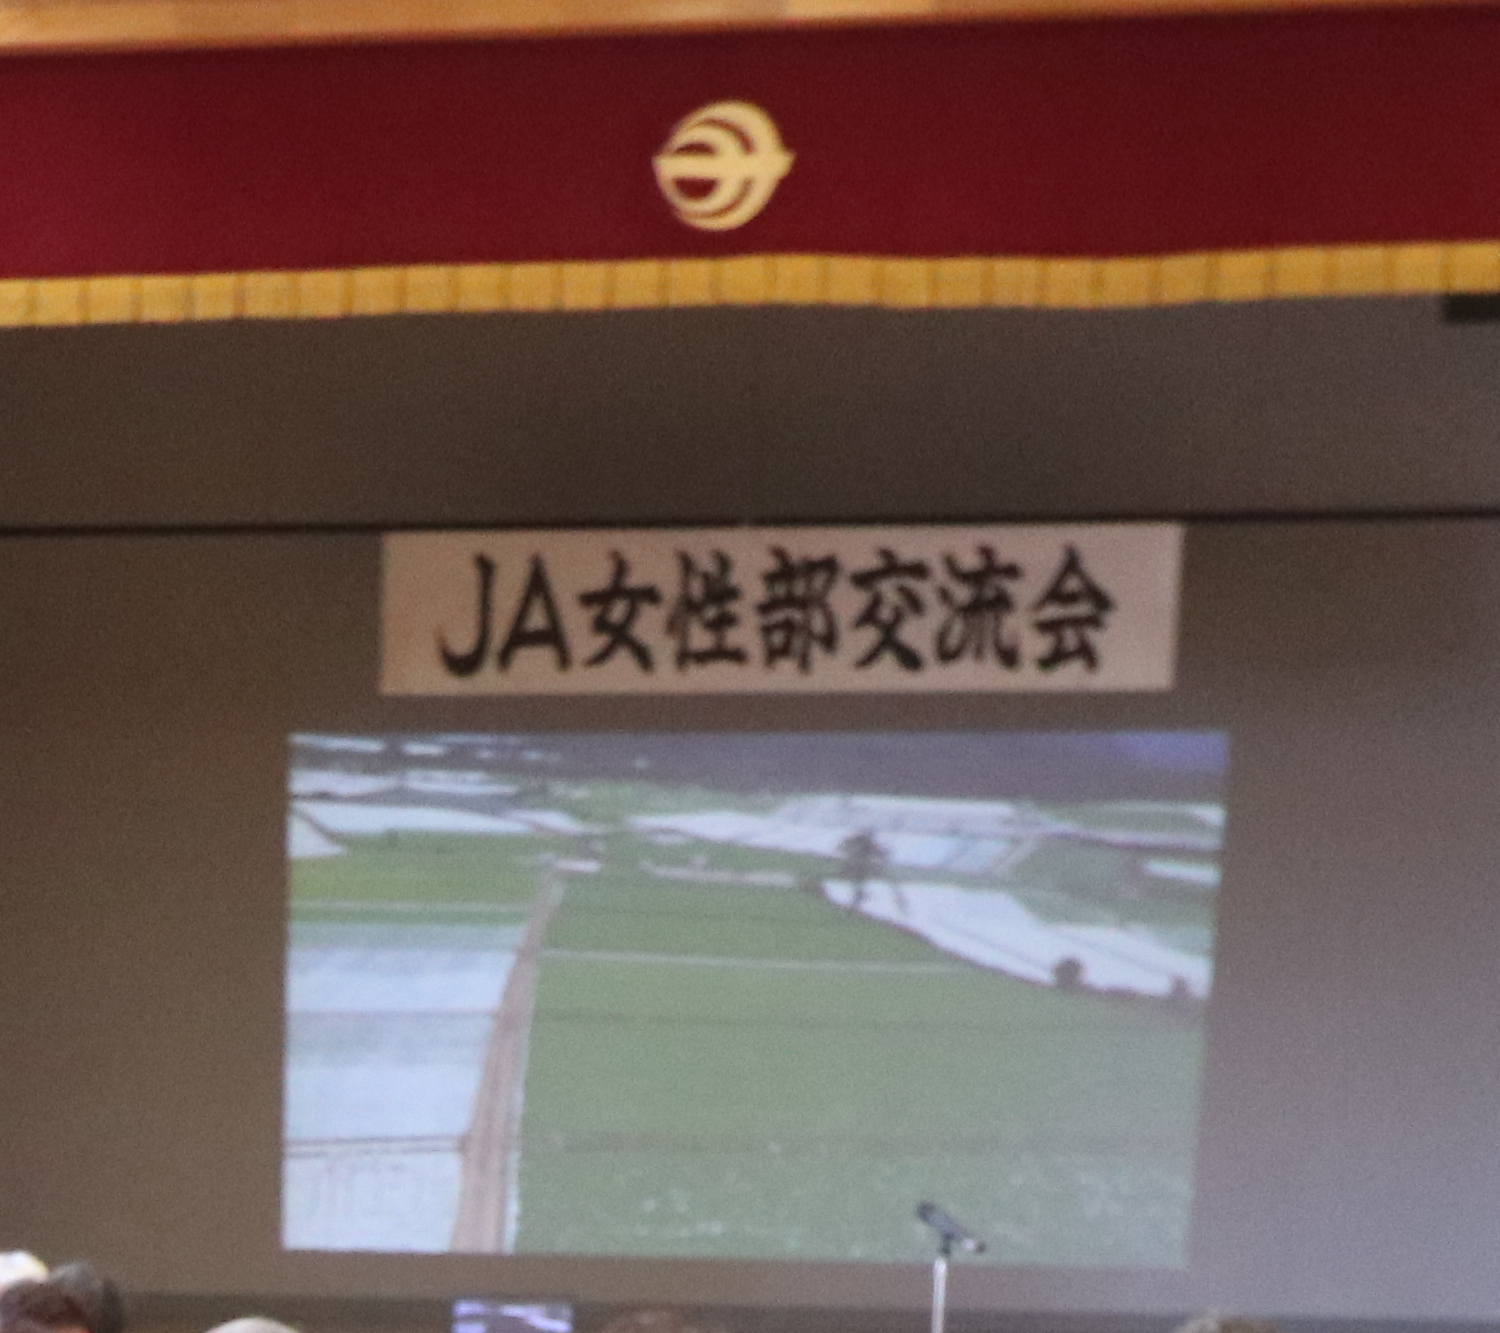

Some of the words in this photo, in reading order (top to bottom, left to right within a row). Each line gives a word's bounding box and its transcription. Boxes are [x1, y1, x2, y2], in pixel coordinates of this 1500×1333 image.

[437, 543, 1116, 679] JA女性部交流会
